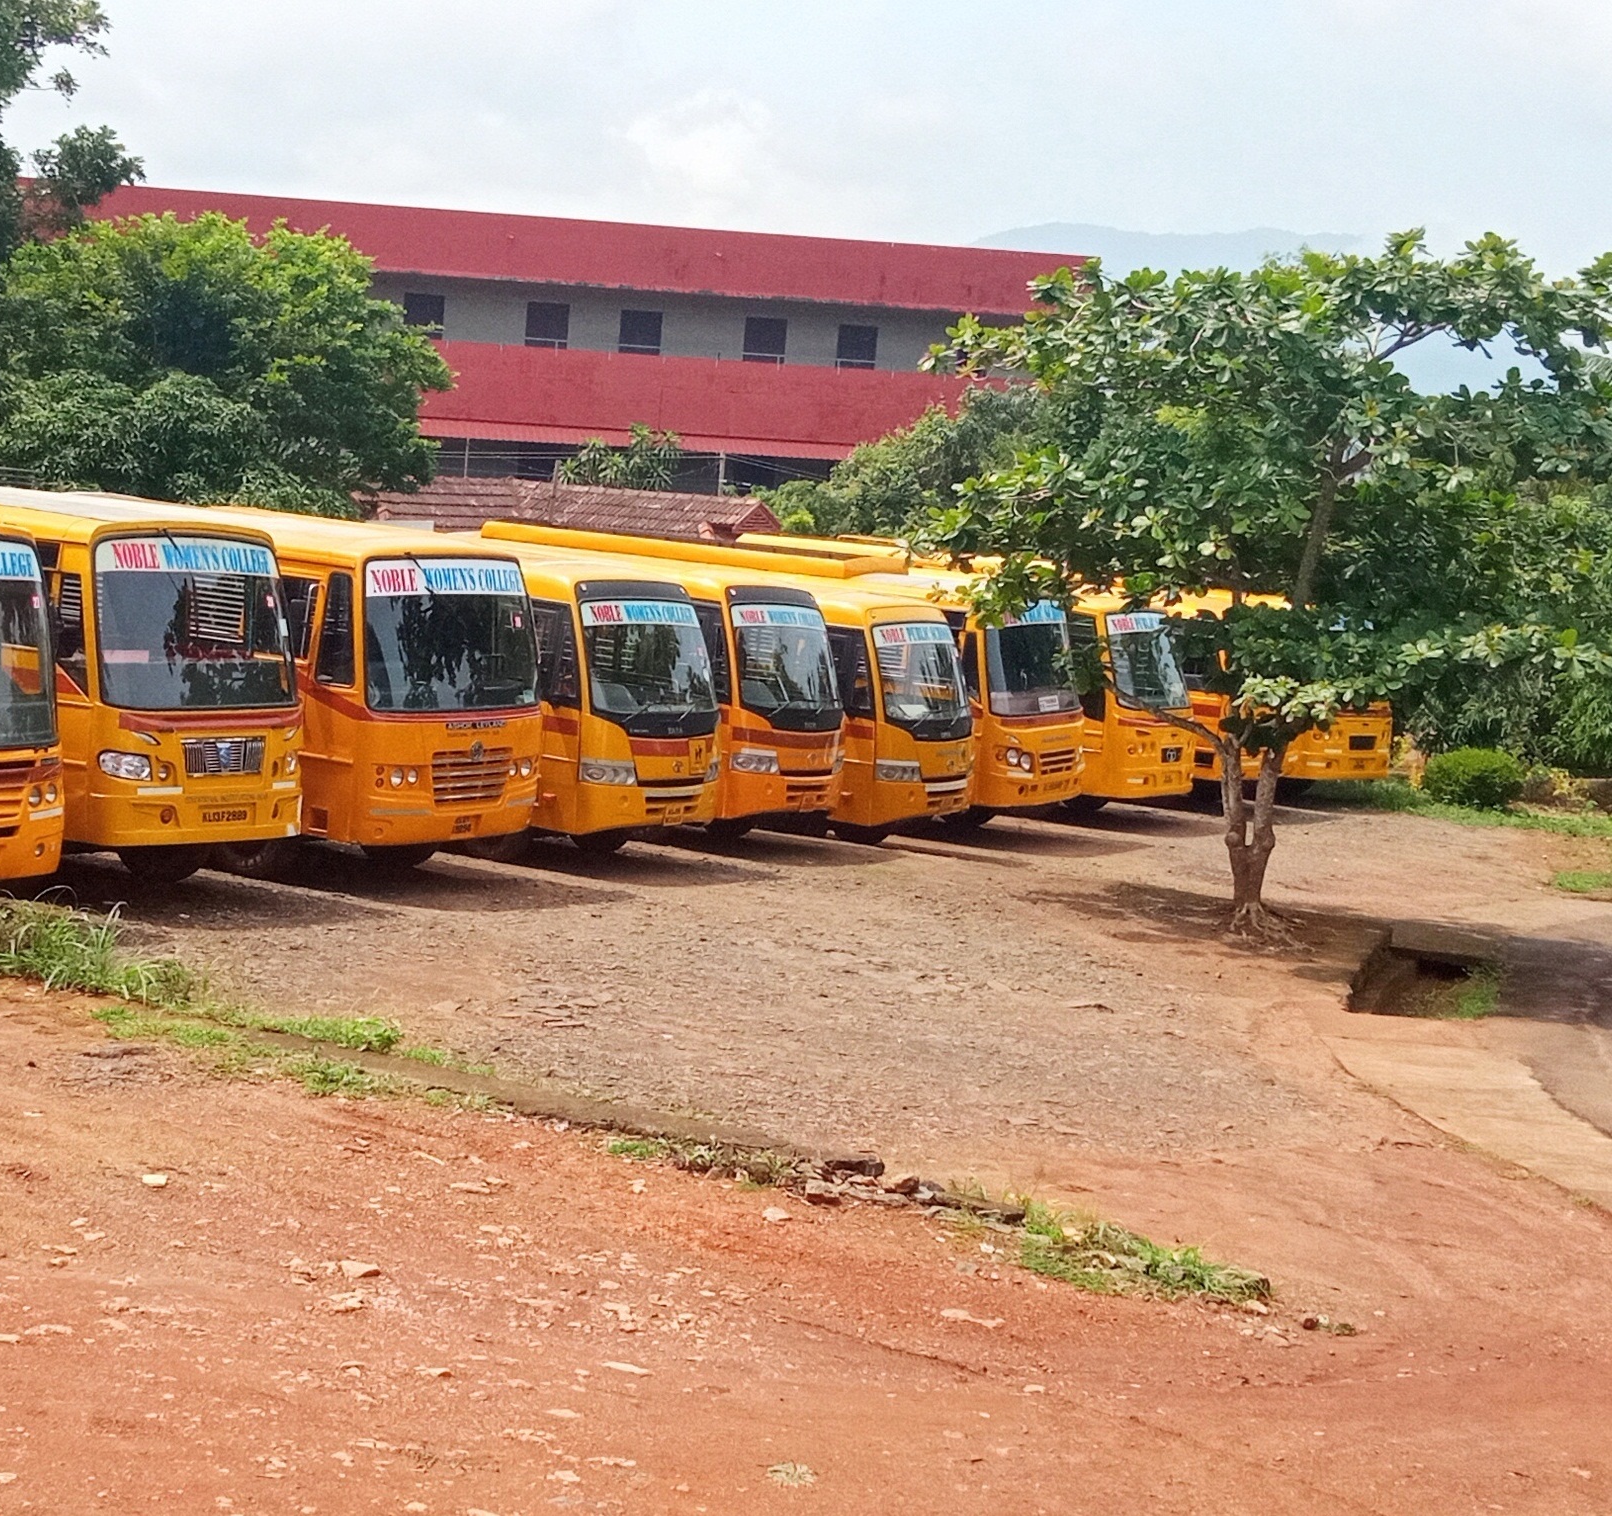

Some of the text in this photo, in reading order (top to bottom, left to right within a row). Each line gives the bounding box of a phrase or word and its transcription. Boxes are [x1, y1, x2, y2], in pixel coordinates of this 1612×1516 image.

[111, 543, 271, 575] NOBLE WOMEN'S COLLEGE
[370, 567, 522, 593] NOBLE WOMEN'S COLLEGE
[589, 604, 624, 623] NOBLE
[739, 610, 767, 624] NOBLE
[879, 628, 907, 643] NOBLE
